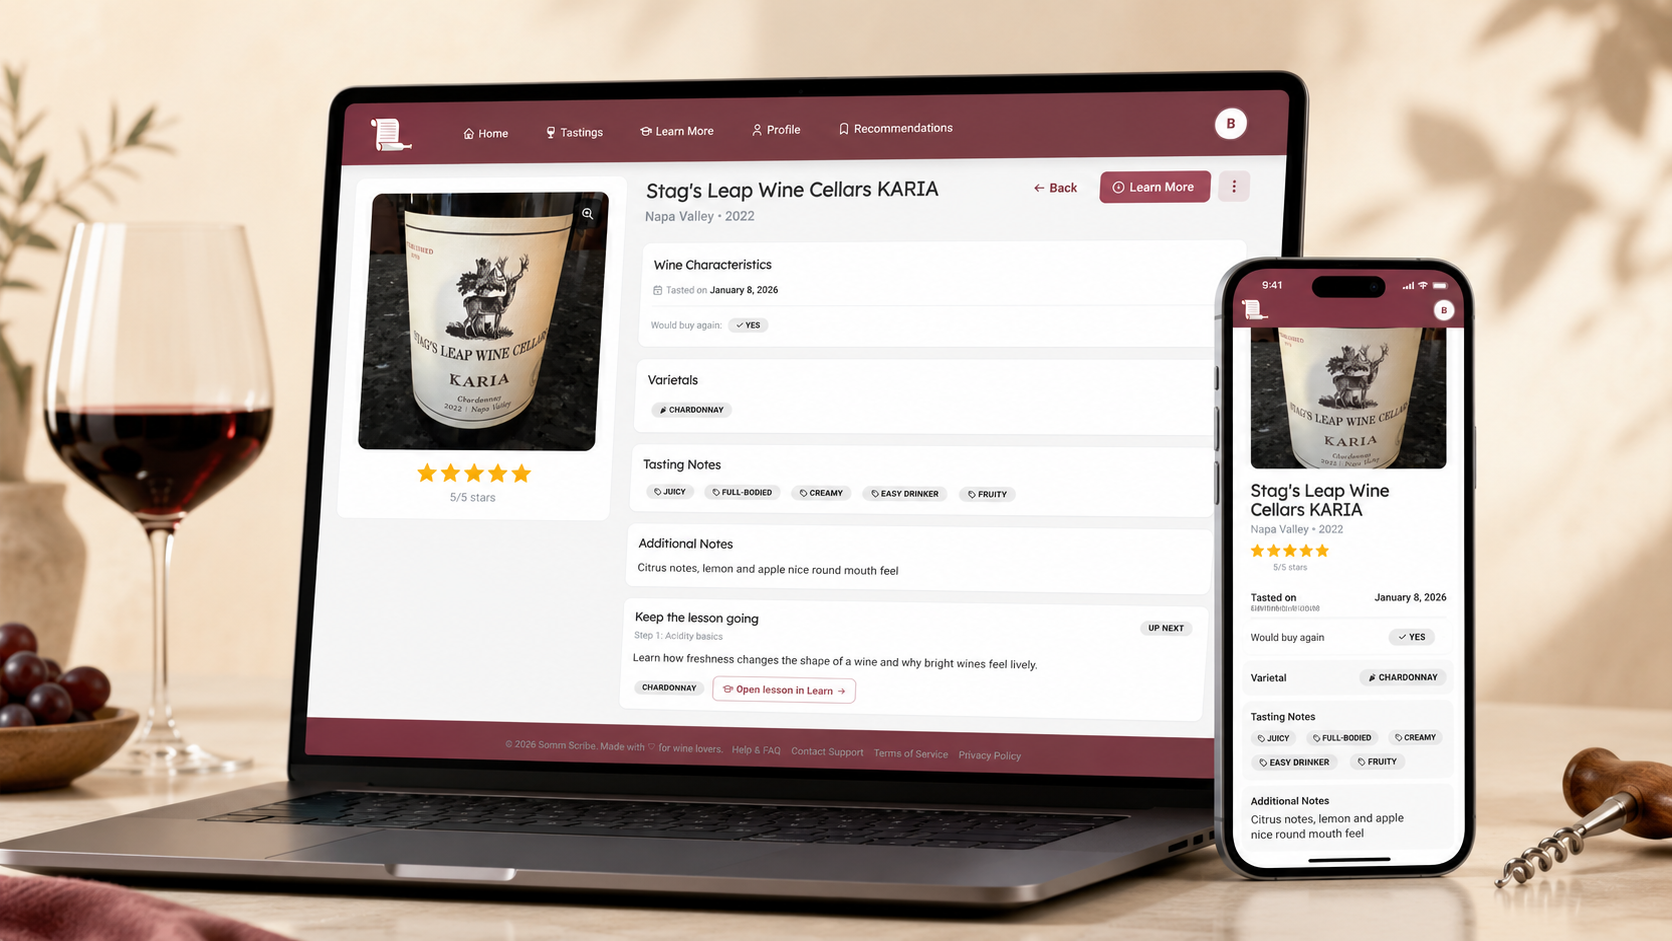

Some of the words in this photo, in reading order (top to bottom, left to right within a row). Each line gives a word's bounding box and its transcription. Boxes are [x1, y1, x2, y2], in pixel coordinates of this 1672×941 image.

[854, 123, 953, 134] Recommendations
[1227, 118, 1235, 129] B
[479, 129, 509, 138] Home
[560, 127, 603, 139] Tastings
[656, 126, 684, 136] Learn
[687, 126, 714, 136] More
[767, 124, 801, 135] Profile
[646, 183, 702, 203] Stag's
[708, 183, 753, 202] Leap
[758, 181, 804, 198] Wine
[810, 181, 872, 198] Cellars
[878, 180, 939, 197] KARIA
[1050, 182, 1077, 193] Back
[1130, 182, 1161, 192] Learn
[1165, 182, 1194, 192] More
[645, 211, 675, 224] Napa
[679, 210, 714, 224] Valley
[725, 210, 755, 221] 2022
[654, 259, 683, 270] Wine
[685, 259, 772, 270] Characteristics
[667, 286, 694, 294] Tasted
[709, 286, 745, 296] January
[746, 285, 755, 295] 8,
[757, 285, 779, 294] 2026
[1262, 281, 1282, 289] 9:41
[651, 321, 677, 329] Would
[679, 321, 695, 331] buy
[696, 321, 722, 331] again:
[440, 345, 472, 361] LEAP
[476, 348, 510, 361] WINE
[450, 373, 509, 387] KARIA
[648, 374, 698, 385] Varietals
[444, 403, 462, 412] 2022
[1315, 414, 1343, 426] LEAP
[1346, 416, 1376, 426] WINE
[1324, 435, 1377, 447] KARIA
[643, 459, 684, 473] Tasting
[687, 459, 721, 470] Notes
[450, 492, 468, 502] 5/5
[470, 493, 496, 503] stars
[722, 488, 772, 496] FULL-BODIED
[1251, 483, 1300, 501] Stag's
[1305, 484, 1345, 501] Leap
[1349, 483, 1390, 498] Wine
[1251, 502, 1305, 517] Cellars
[1310, 502, 1363, 517] KARIA
[1251, 525, 1277, 536] Napa
[1279, 524, 1309, 536] Valley
[1318, 524, 1343, 534] 2022
[638, 538, 697, 549] Additional
[700, 539, 733, 549] Notes
[637, 562, 667, 573] Citrus
[669, 564, 700, 574] notes,
[702, 563, 734, 573] lemon
[736, 564, 755, 574] and
[757, 564, 786, 576] apple
[788, 565, 809, 575] nice
[812, 565, 841, 575] round
[844, 566, 877, 575] mouth
[880, 565, 899, 576] feel
[1273, 563, 1287, 571] 5/5
[1251, 593, 1282, 602] Tasted
[1374, 593, 1411, 604] January
[1413, 593, 1422, 603] 8,
[1424, 592, 1447, 602] 2026
[635, 612, 664, 625] Keep
[667, 612, 685, 623] the
[688, 612, 723, 623] lesson
[726, 613, 759, 627] going
[634, 631, 654, 641] Step
[656, 631, 663, 640] 1:
[664, 631, 694, 642] Acidity
[696, 632, 723, 641] basics
[1250, 633, 1279, 642] Would
[1281, 633, 1298, 644] buy
[1299, 633, 1325, 644] again
[1409, 633, 1426, 641] YES
[633, 653, 661, 662] Learn
[663, 653, 684, 663] how
[686, 653, 735, 664] freshness
[737, 654, 779, 667] changes
[781, 655, 798, 665] the
[800, 656, 830, 667] shape
[832, 656, 844, 666] of
[854, 657, 878, 667] wine
[880, 657, 899, 667] and
[901, 658, 922, 670] why
[924, 658, 954, 670] bright
[956, 659, 986, 669] wines
[989, 659, 1008, 669] feel
[1010, 659, 1037, 672] lively.
[1250, 673, 1287, 682] Varietal
[1378, 673, 1438, 681] CHARDONNAY
[736, 685, 760, 695] Open
[762, 685, 793, 694] lesson
[795, 686, 805, 694] in
[807, 686, 833, 695] Learn
[1250, 712, 1285, 723] Tasting
[1288, 712, 1316, 721] Notes
[514, 740, 537, 749] 2026
[538, 740, 567, 749] Somm
[568, 741, 598, 750] Scribe.
[600, 742, 625, 751] Made
[626, 743, 645, 751] with
[658, 743, 671, 752] for
[673, 743, 694, 753] wine
[695, 744, 723, 753] lovers.
[732, 745, 752, 756] Help
[754, 746, 761, 754] &
[763, 746, 781, 756] FAQ
[791, 746, 826, 756] Contact
[828, 747, 864, 758] Support
[873, 748, 902, 758] Terms
[904, 749, 914, 758] of
[915, 749, 949, 759] Service
[958, 750, 992, 762] Privacy
[994, 751, 1022, 762] Policy
[1270, 758, 1291, 766] EASY
[1293, 758, 1330, 766] DRINKER
[1250, 796, 1299, 806] Additional
[1301, 796, 1330, 805] Notes
[1251, 814, 1282, 824] Citrus
[1284, 815, 1316, 825] notes,
[1319, 814, 1351, 824] lemon
[1353, 813, 1373, 823] and
[1375, 813, 1404, 824] apple
[1251, 830, 1273, 840] nice
[1275, 829, 1306, 839] round
[1308, 828, 1342, 839] mouth
[1345, 828, 1364, 838] feel
